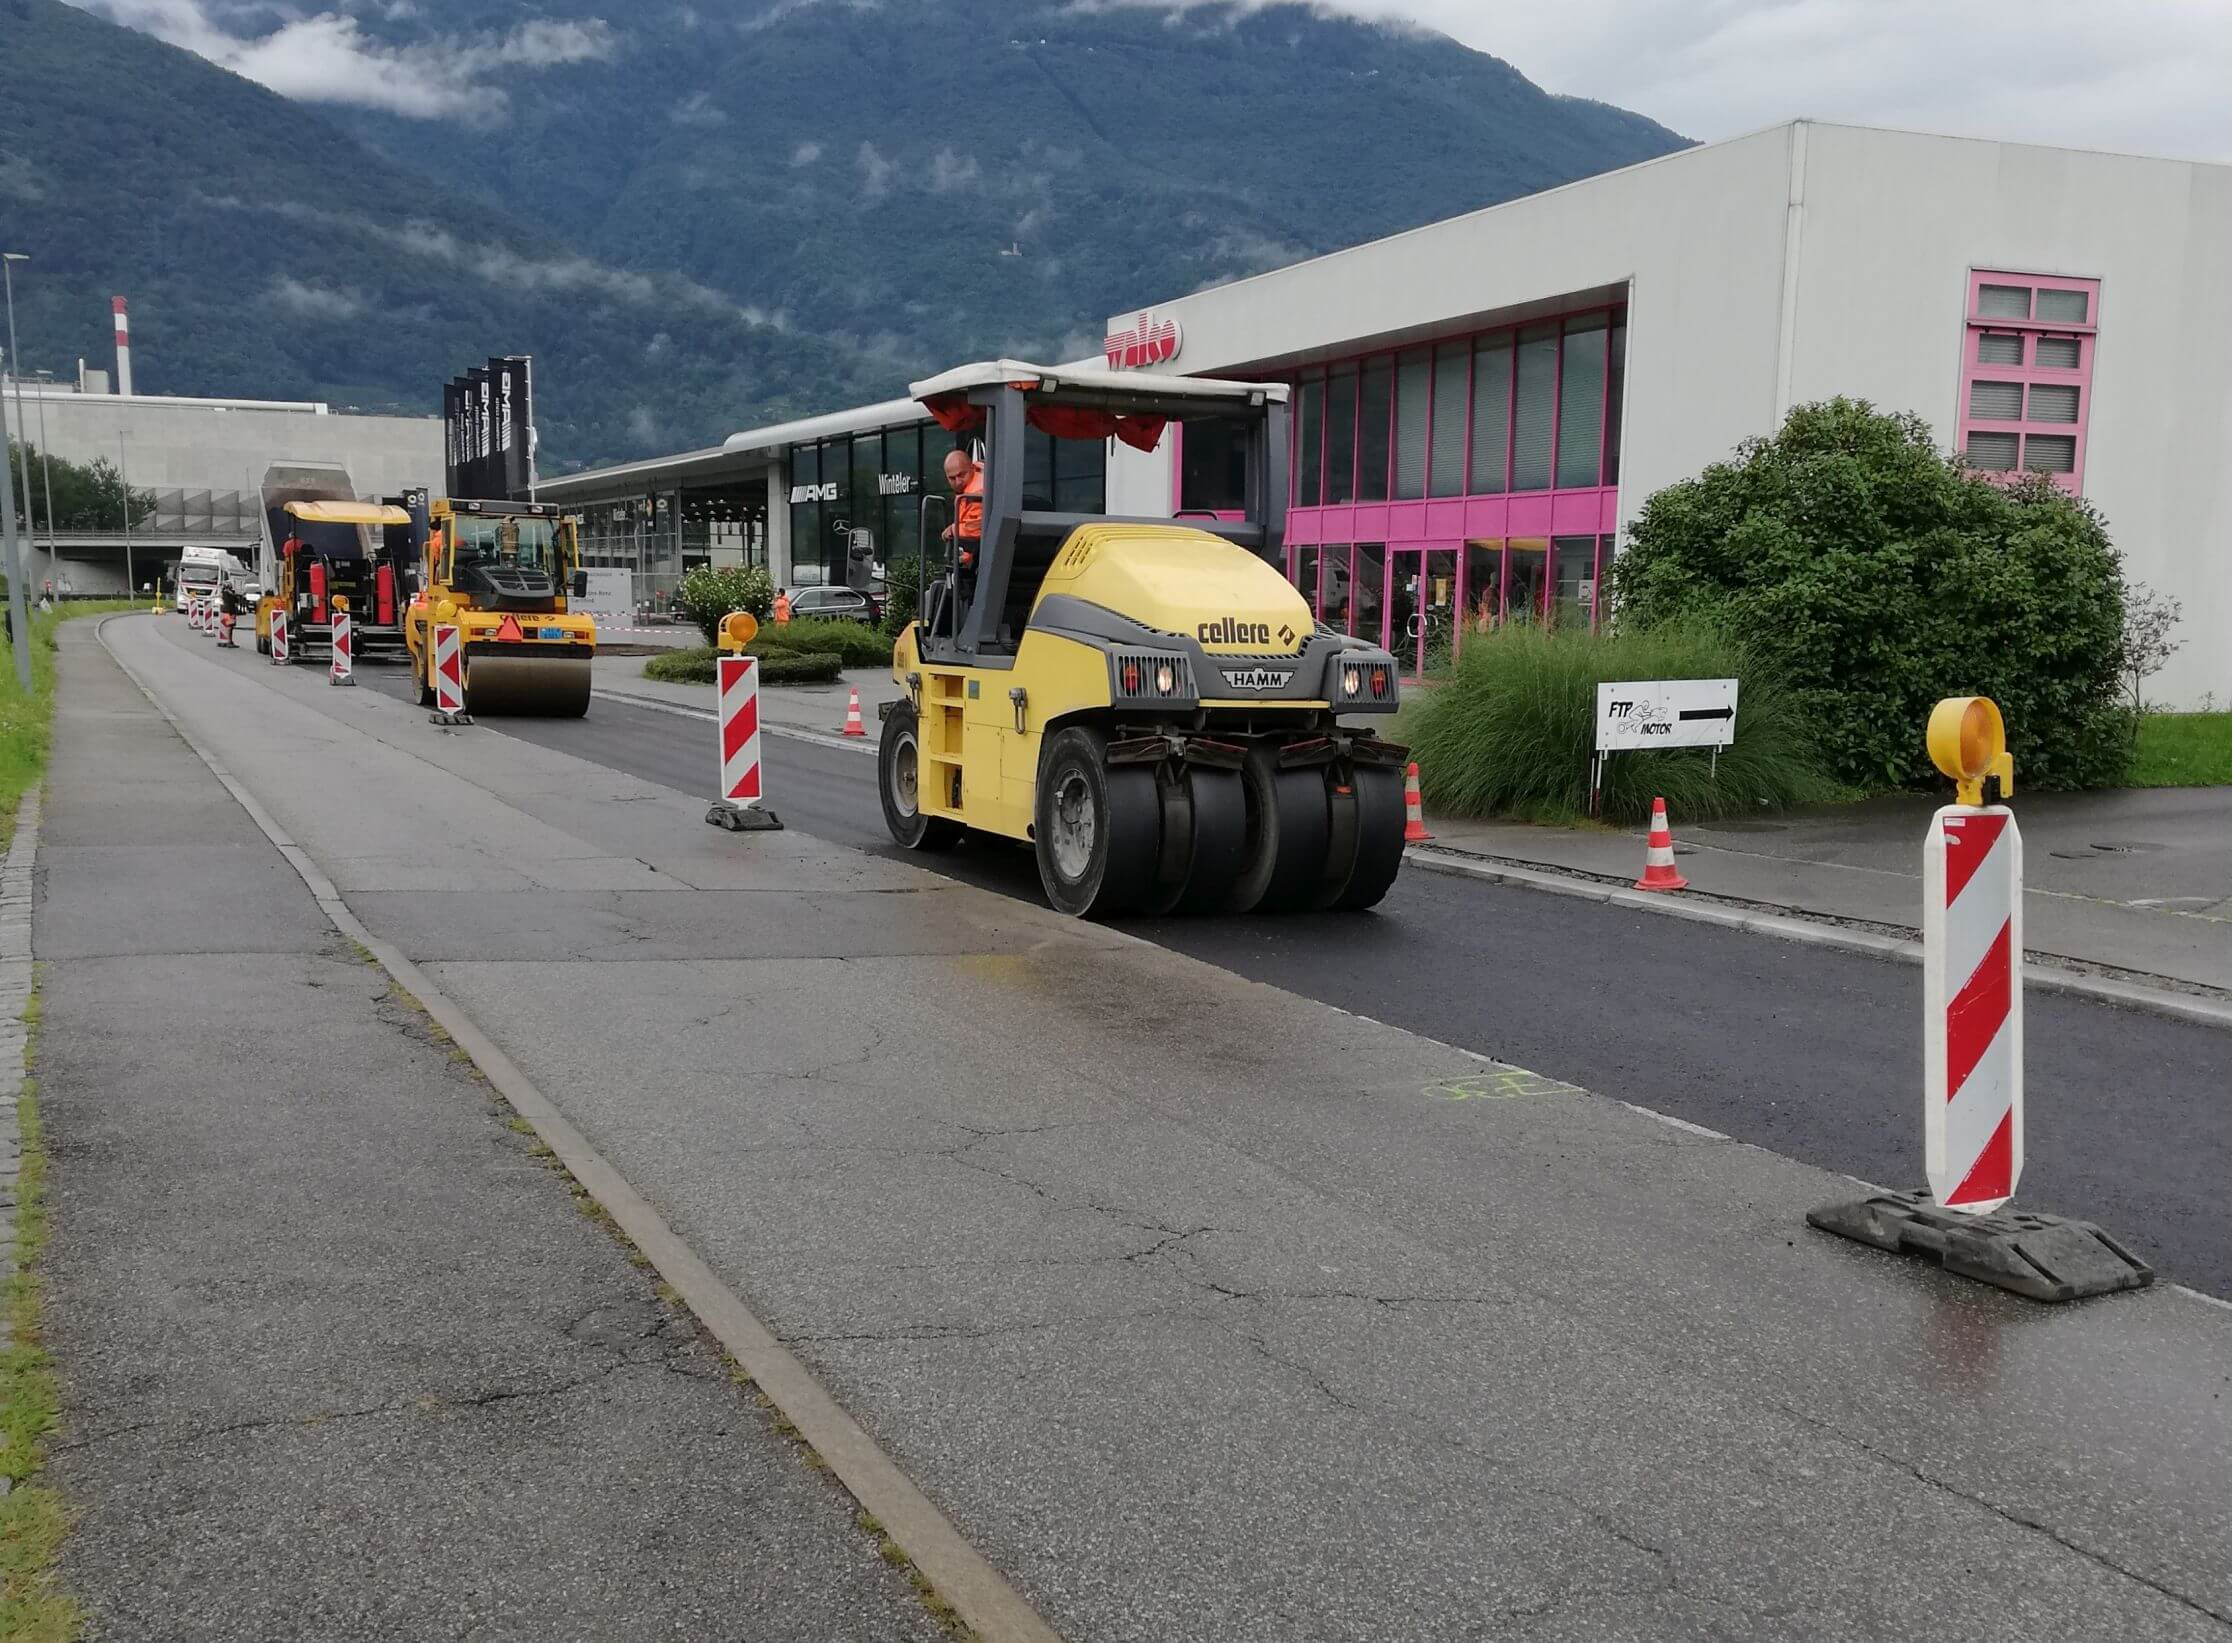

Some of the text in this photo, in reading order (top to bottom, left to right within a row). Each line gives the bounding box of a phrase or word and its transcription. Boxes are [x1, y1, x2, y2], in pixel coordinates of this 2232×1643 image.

[805, 483, 838, 501] AMG
[1198, 617, 1269, 643] cellere
[1234, 673, 1282, 686] HAMM
[1608, 702, 1633, 718] FTP
[1640, 723, 1672, 735] MOTOR
